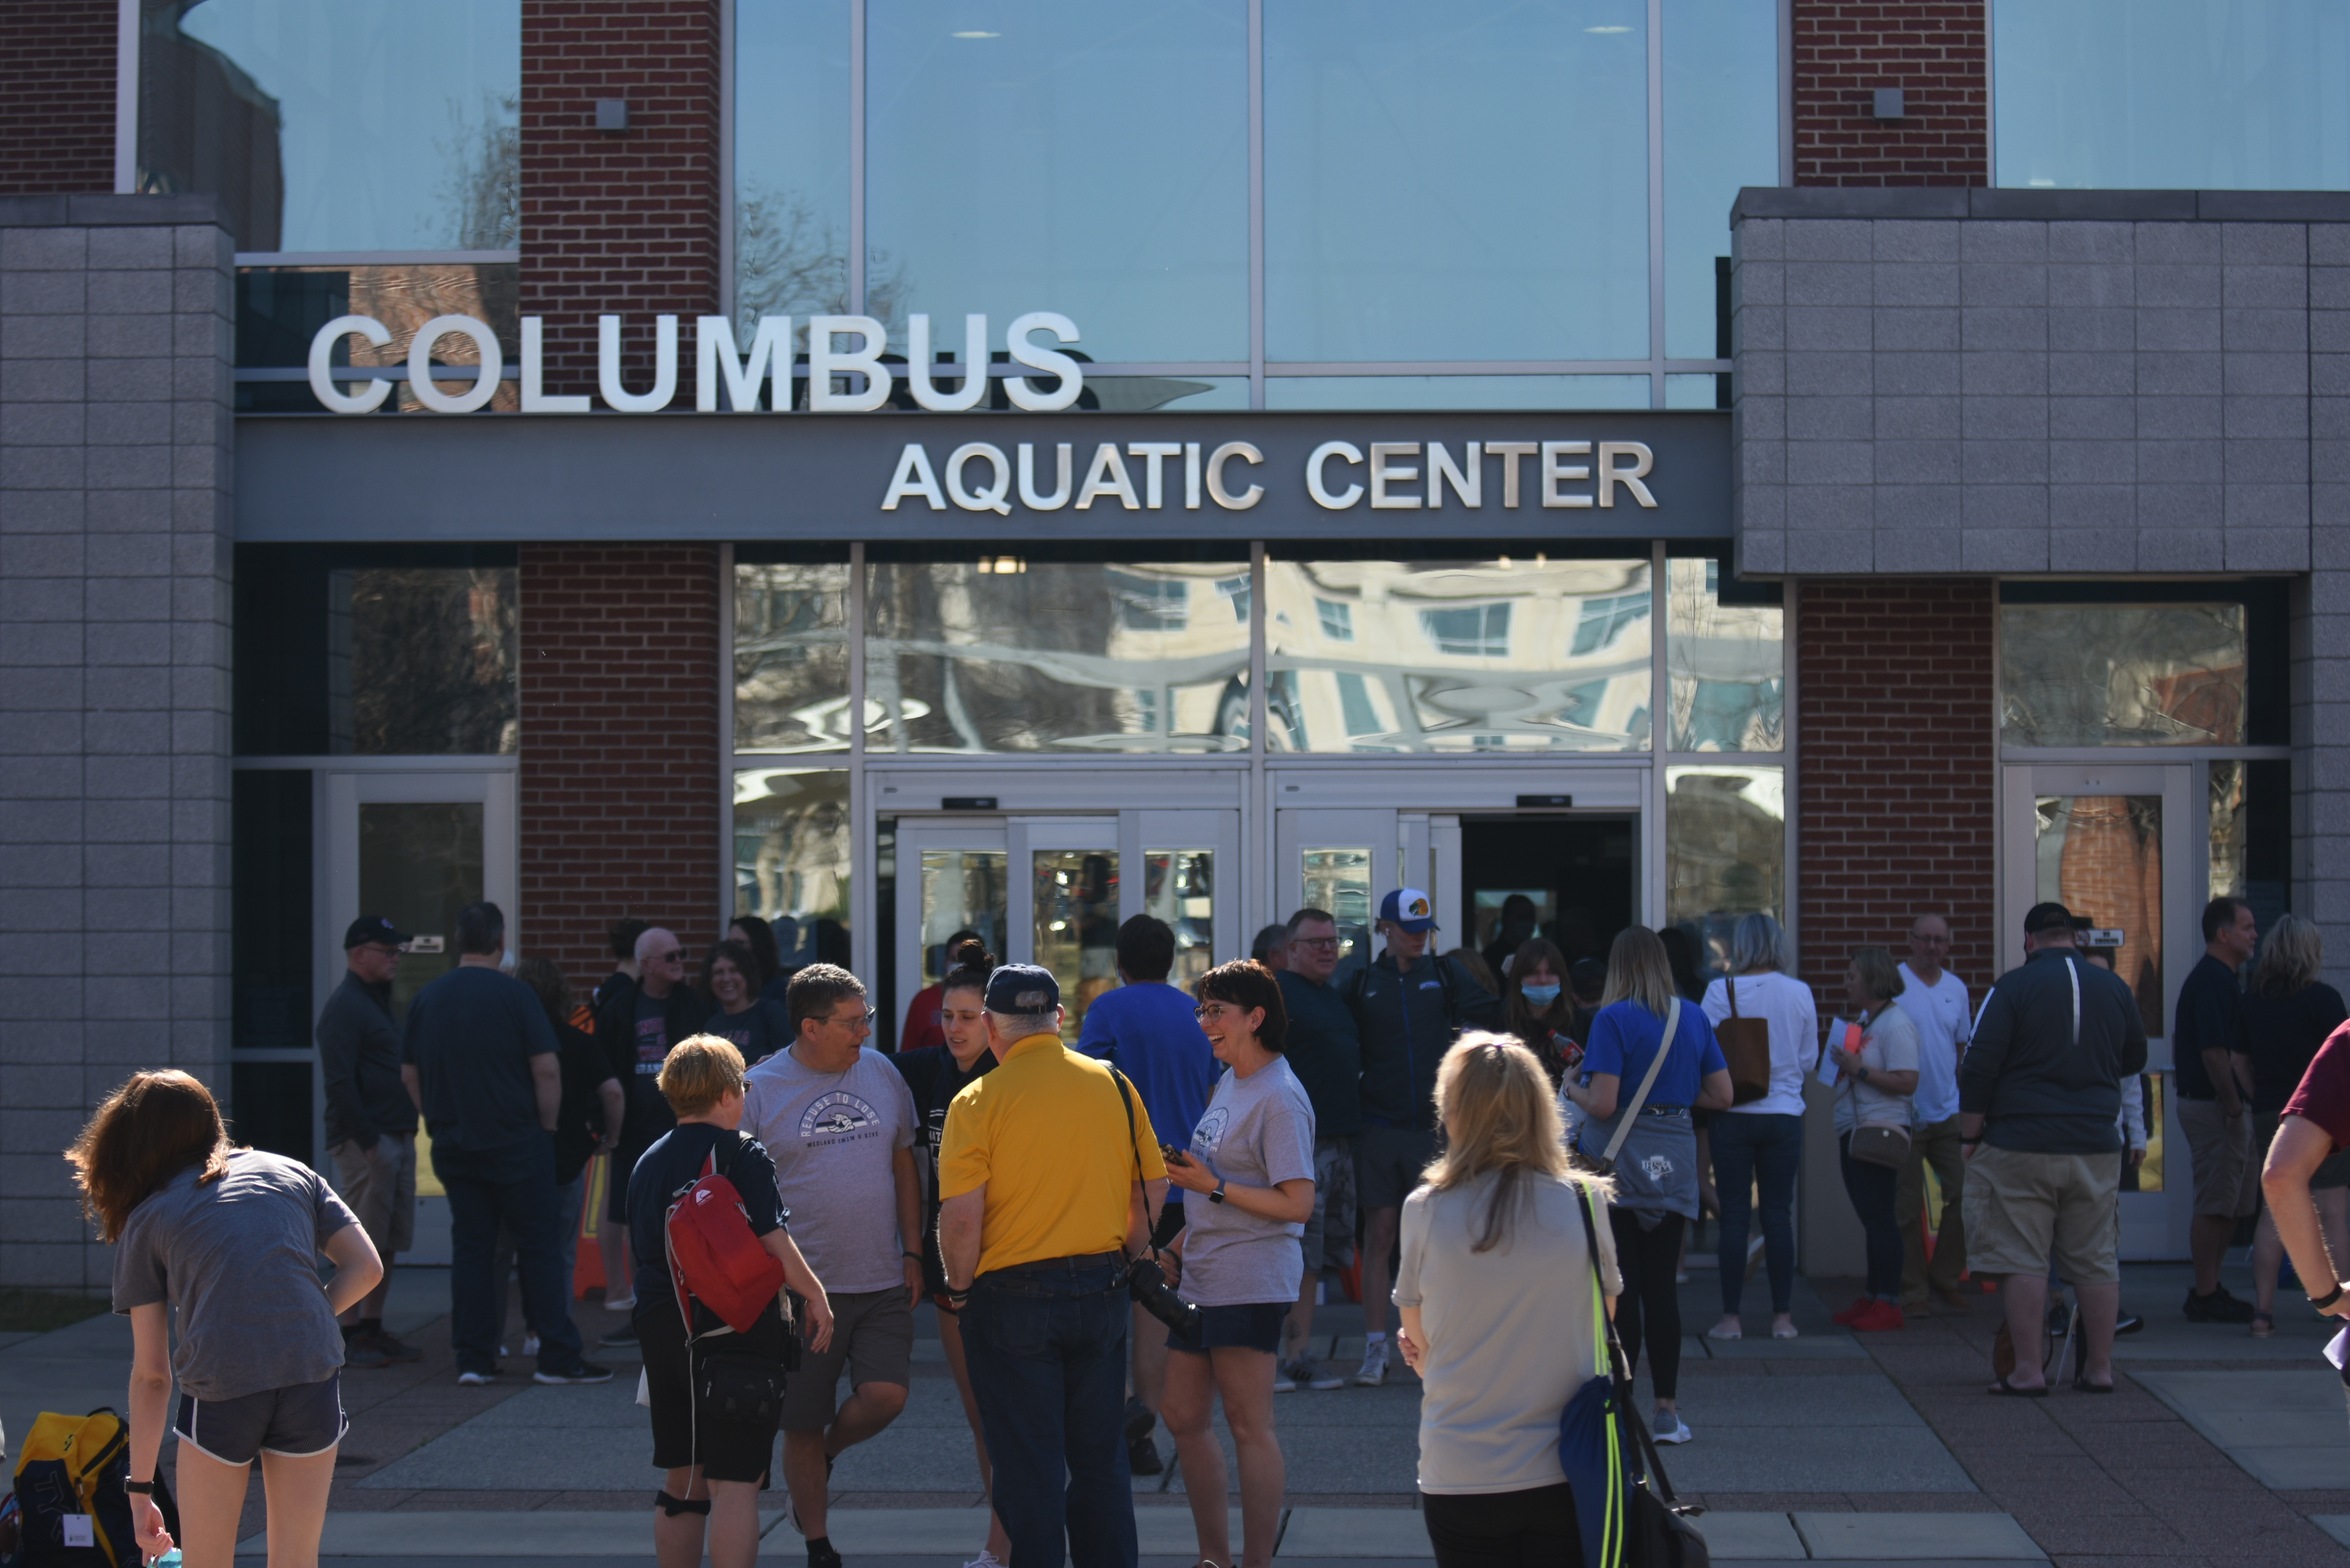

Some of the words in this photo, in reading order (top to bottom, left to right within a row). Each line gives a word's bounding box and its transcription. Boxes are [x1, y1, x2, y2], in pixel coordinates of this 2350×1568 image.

[308, 311, 1083, 415] COLUMBUS
[880, 442, 1265, 516] AQUATIC
[1305, 441, 1658, 510] CENTER
[801, 1095, 831, 1138] REFUSE
[836, 1092, 849, 1104] TO
[854, 1099, 880, 1126] LOSE
[837, 1135, 855, 1144] SWIM
